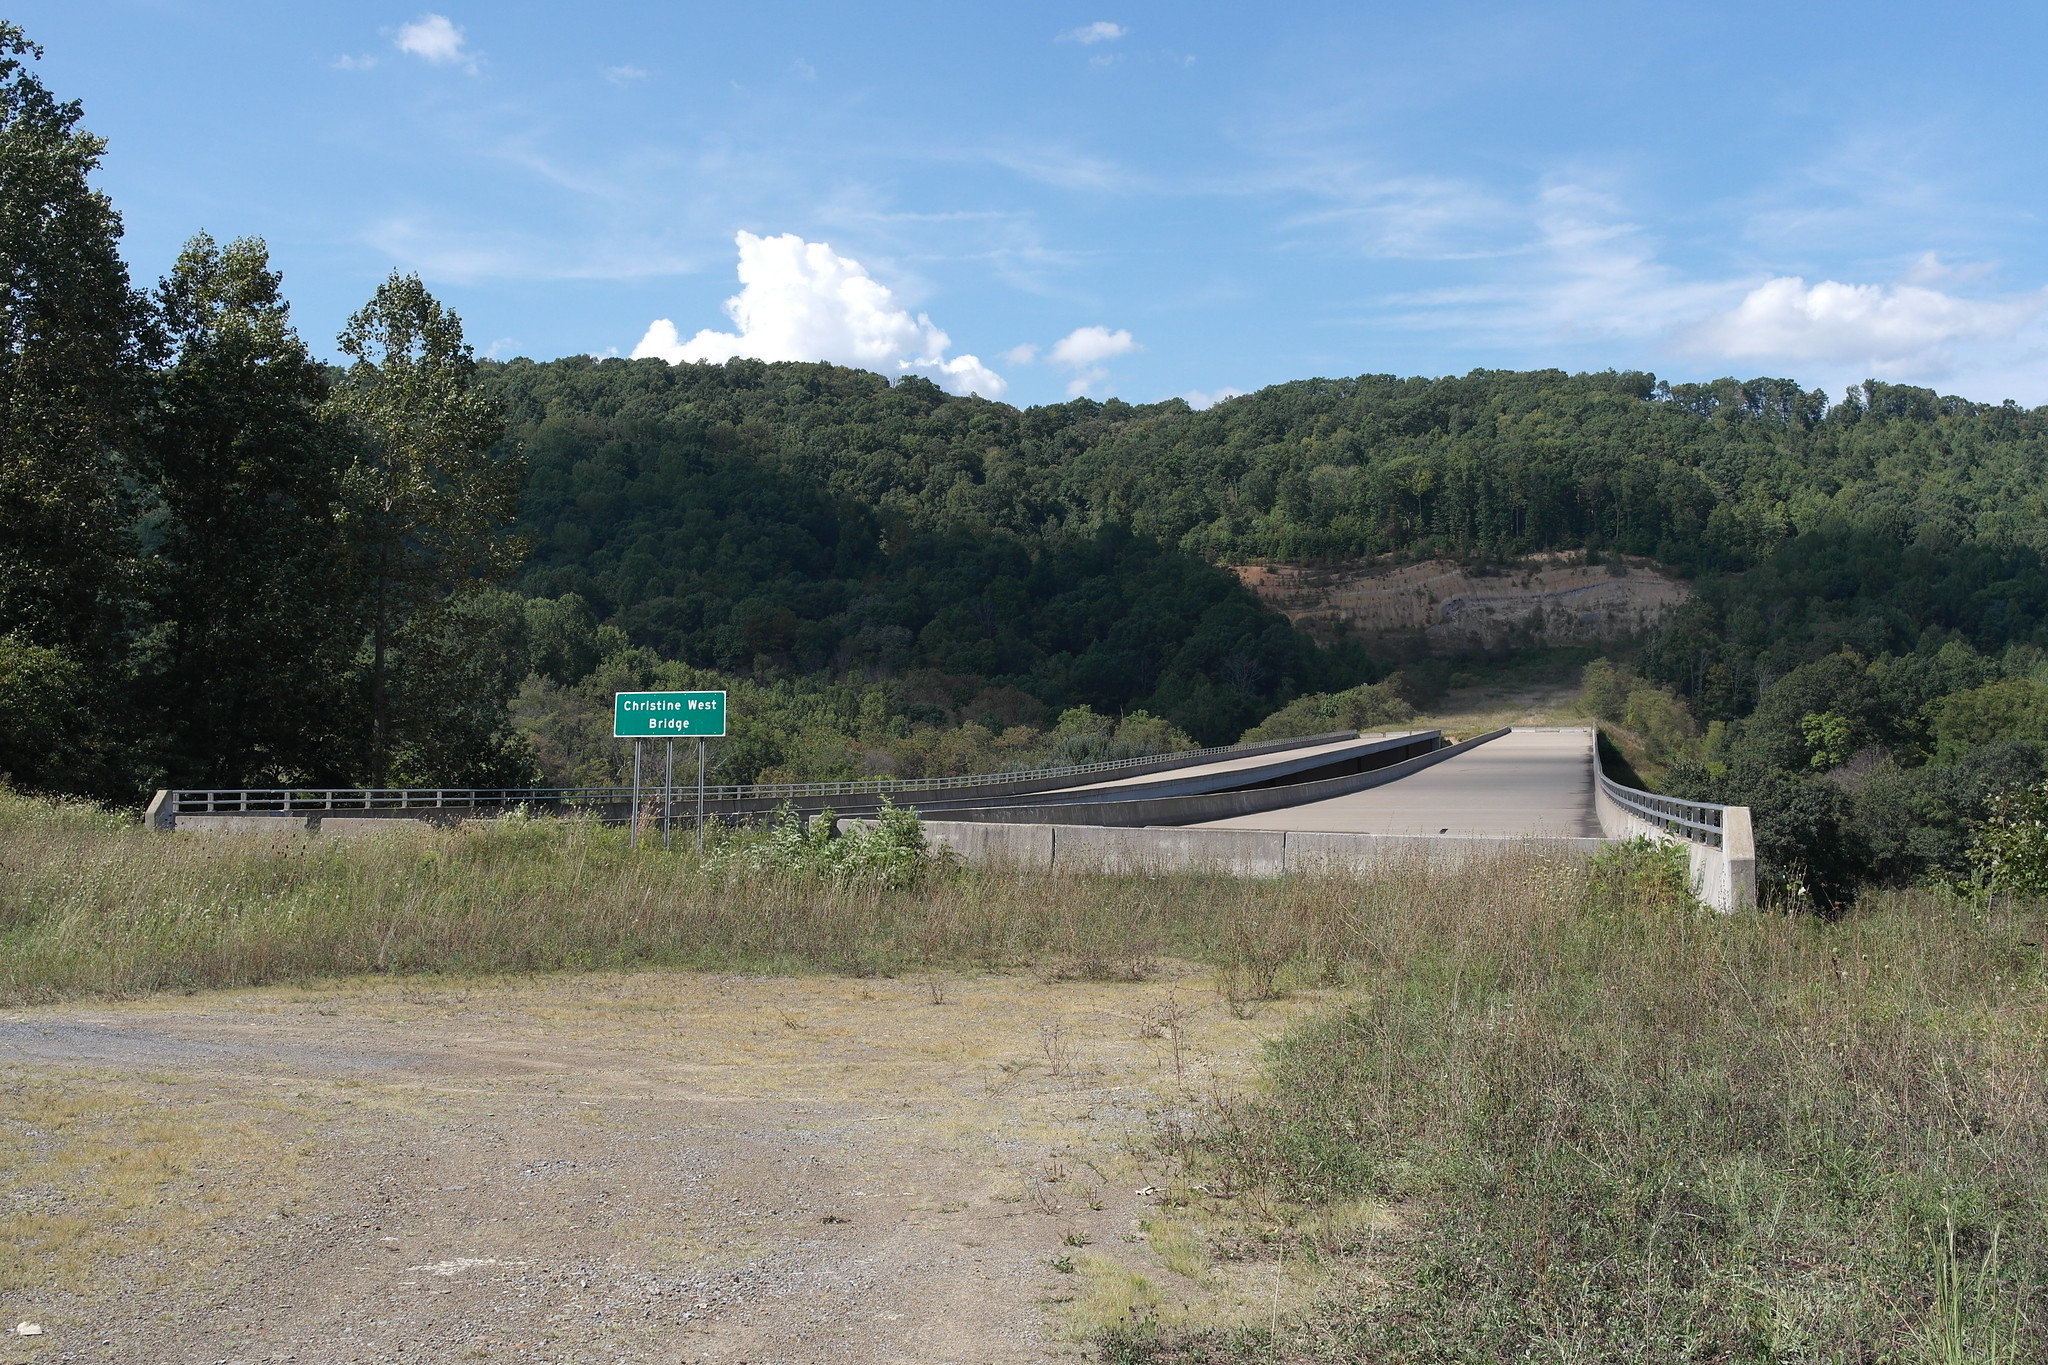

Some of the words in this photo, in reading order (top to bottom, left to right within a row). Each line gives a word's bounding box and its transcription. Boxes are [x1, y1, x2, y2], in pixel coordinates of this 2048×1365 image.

[624, 700, 681, 711] Christine
[688, 699, 717, 710] West
[649, 718, 690, 731] Bridge
